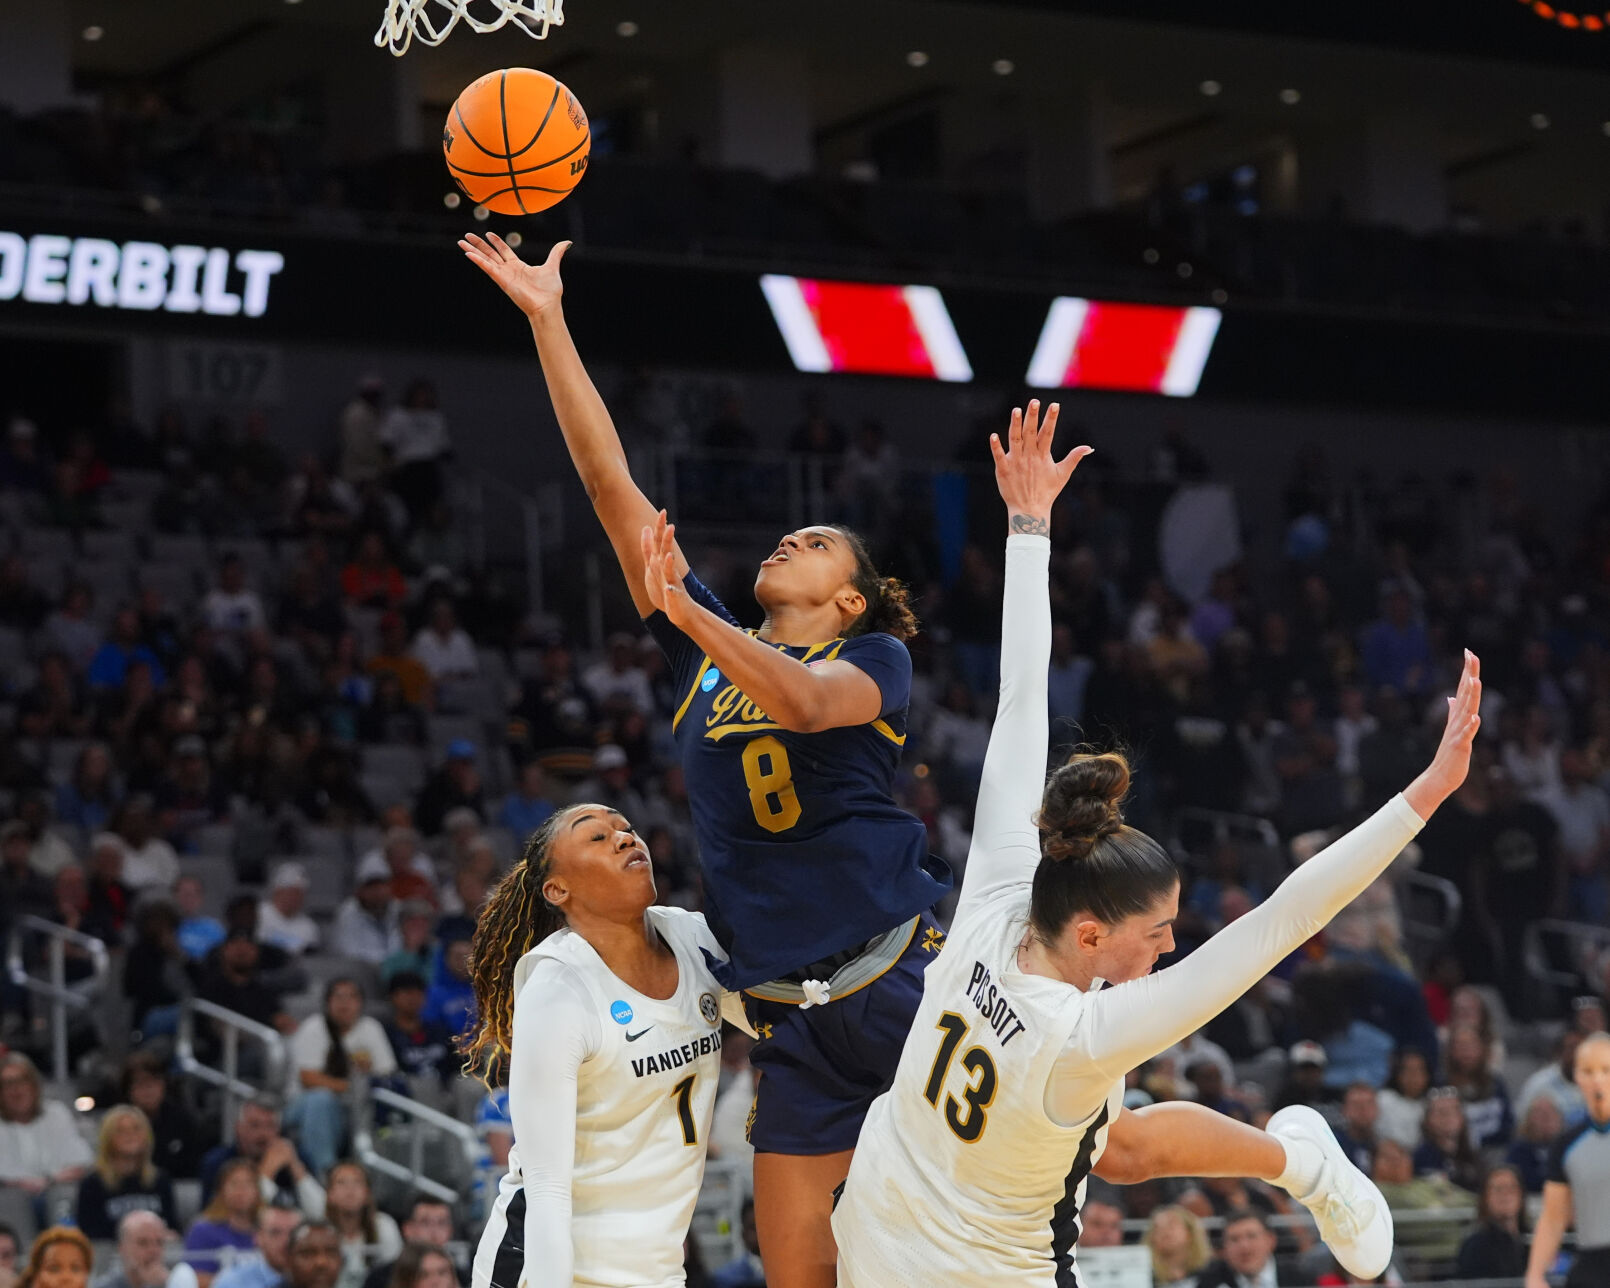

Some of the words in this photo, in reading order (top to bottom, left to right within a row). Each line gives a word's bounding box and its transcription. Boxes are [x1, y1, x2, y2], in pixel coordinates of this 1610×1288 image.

[186, 350, 268, 393] 107
[742, 736, 802, 833] 8
[614, 1009, 633, 1020] NCAA
[966, 960, 1026, 1047] PISSOTT
[670, 1073, 698, 1146] 1
[923, 1010, 999, 1144] 13
